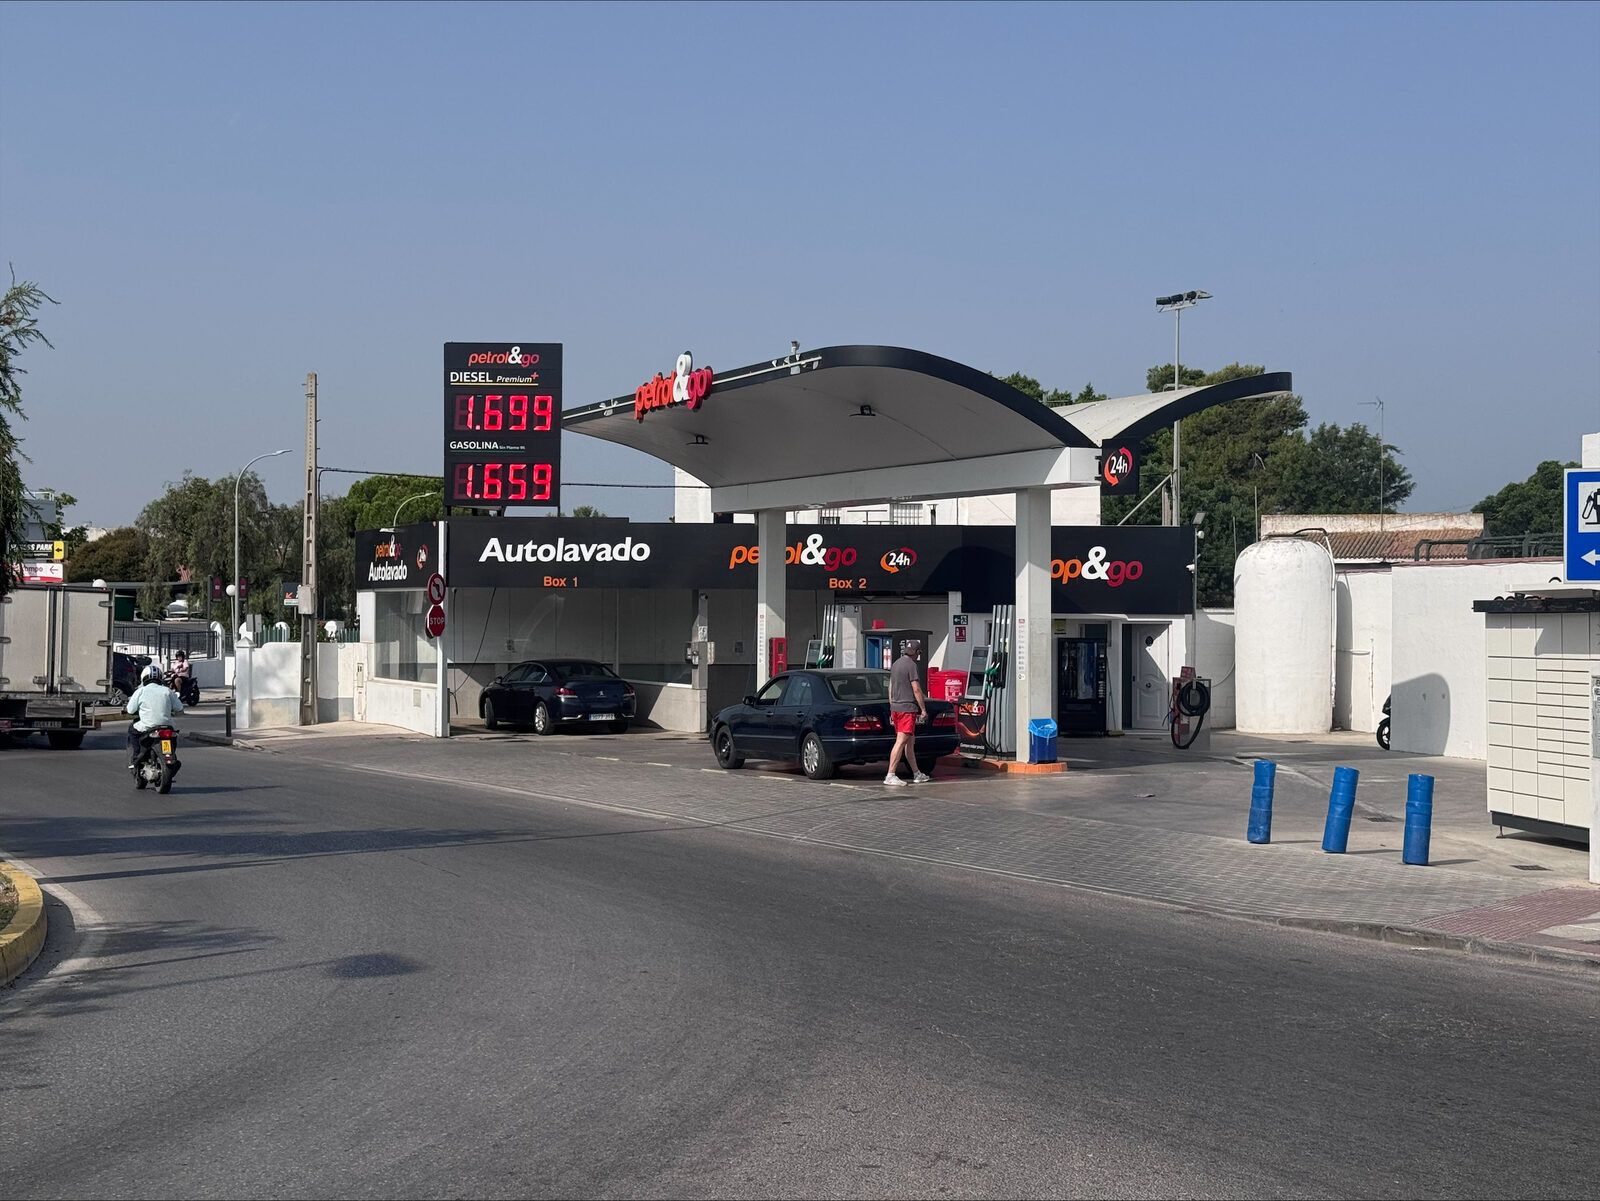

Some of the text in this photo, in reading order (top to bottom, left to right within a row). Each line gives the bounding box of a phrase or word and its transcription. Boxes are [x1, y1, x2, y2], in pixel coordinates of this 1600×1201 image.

[468, 346, 540, 368] petrol&go
[450, 371, 493, 383] DIESEL
[634, 352, 713, 420] petrol&go
[466, 395, 552, 431] 1.699
[449, 441, 499, 450] GASOLINA
[1110, 455, 1128, 474] 24h
[466, 463, 552, 499] 1.659
[36, 543, 53, 551] PARK
[479, 536, 651, 563] Autolavado
[729, 533, 857, 572] peol&go
[888, 552, 911, 566] 24h
[368, 560, 408, 581] Autolavado
[543, 576, 578, 587] Box 1
[829, 577, 867, 589] Box 2
[429, 617, 445, 625] STOP
